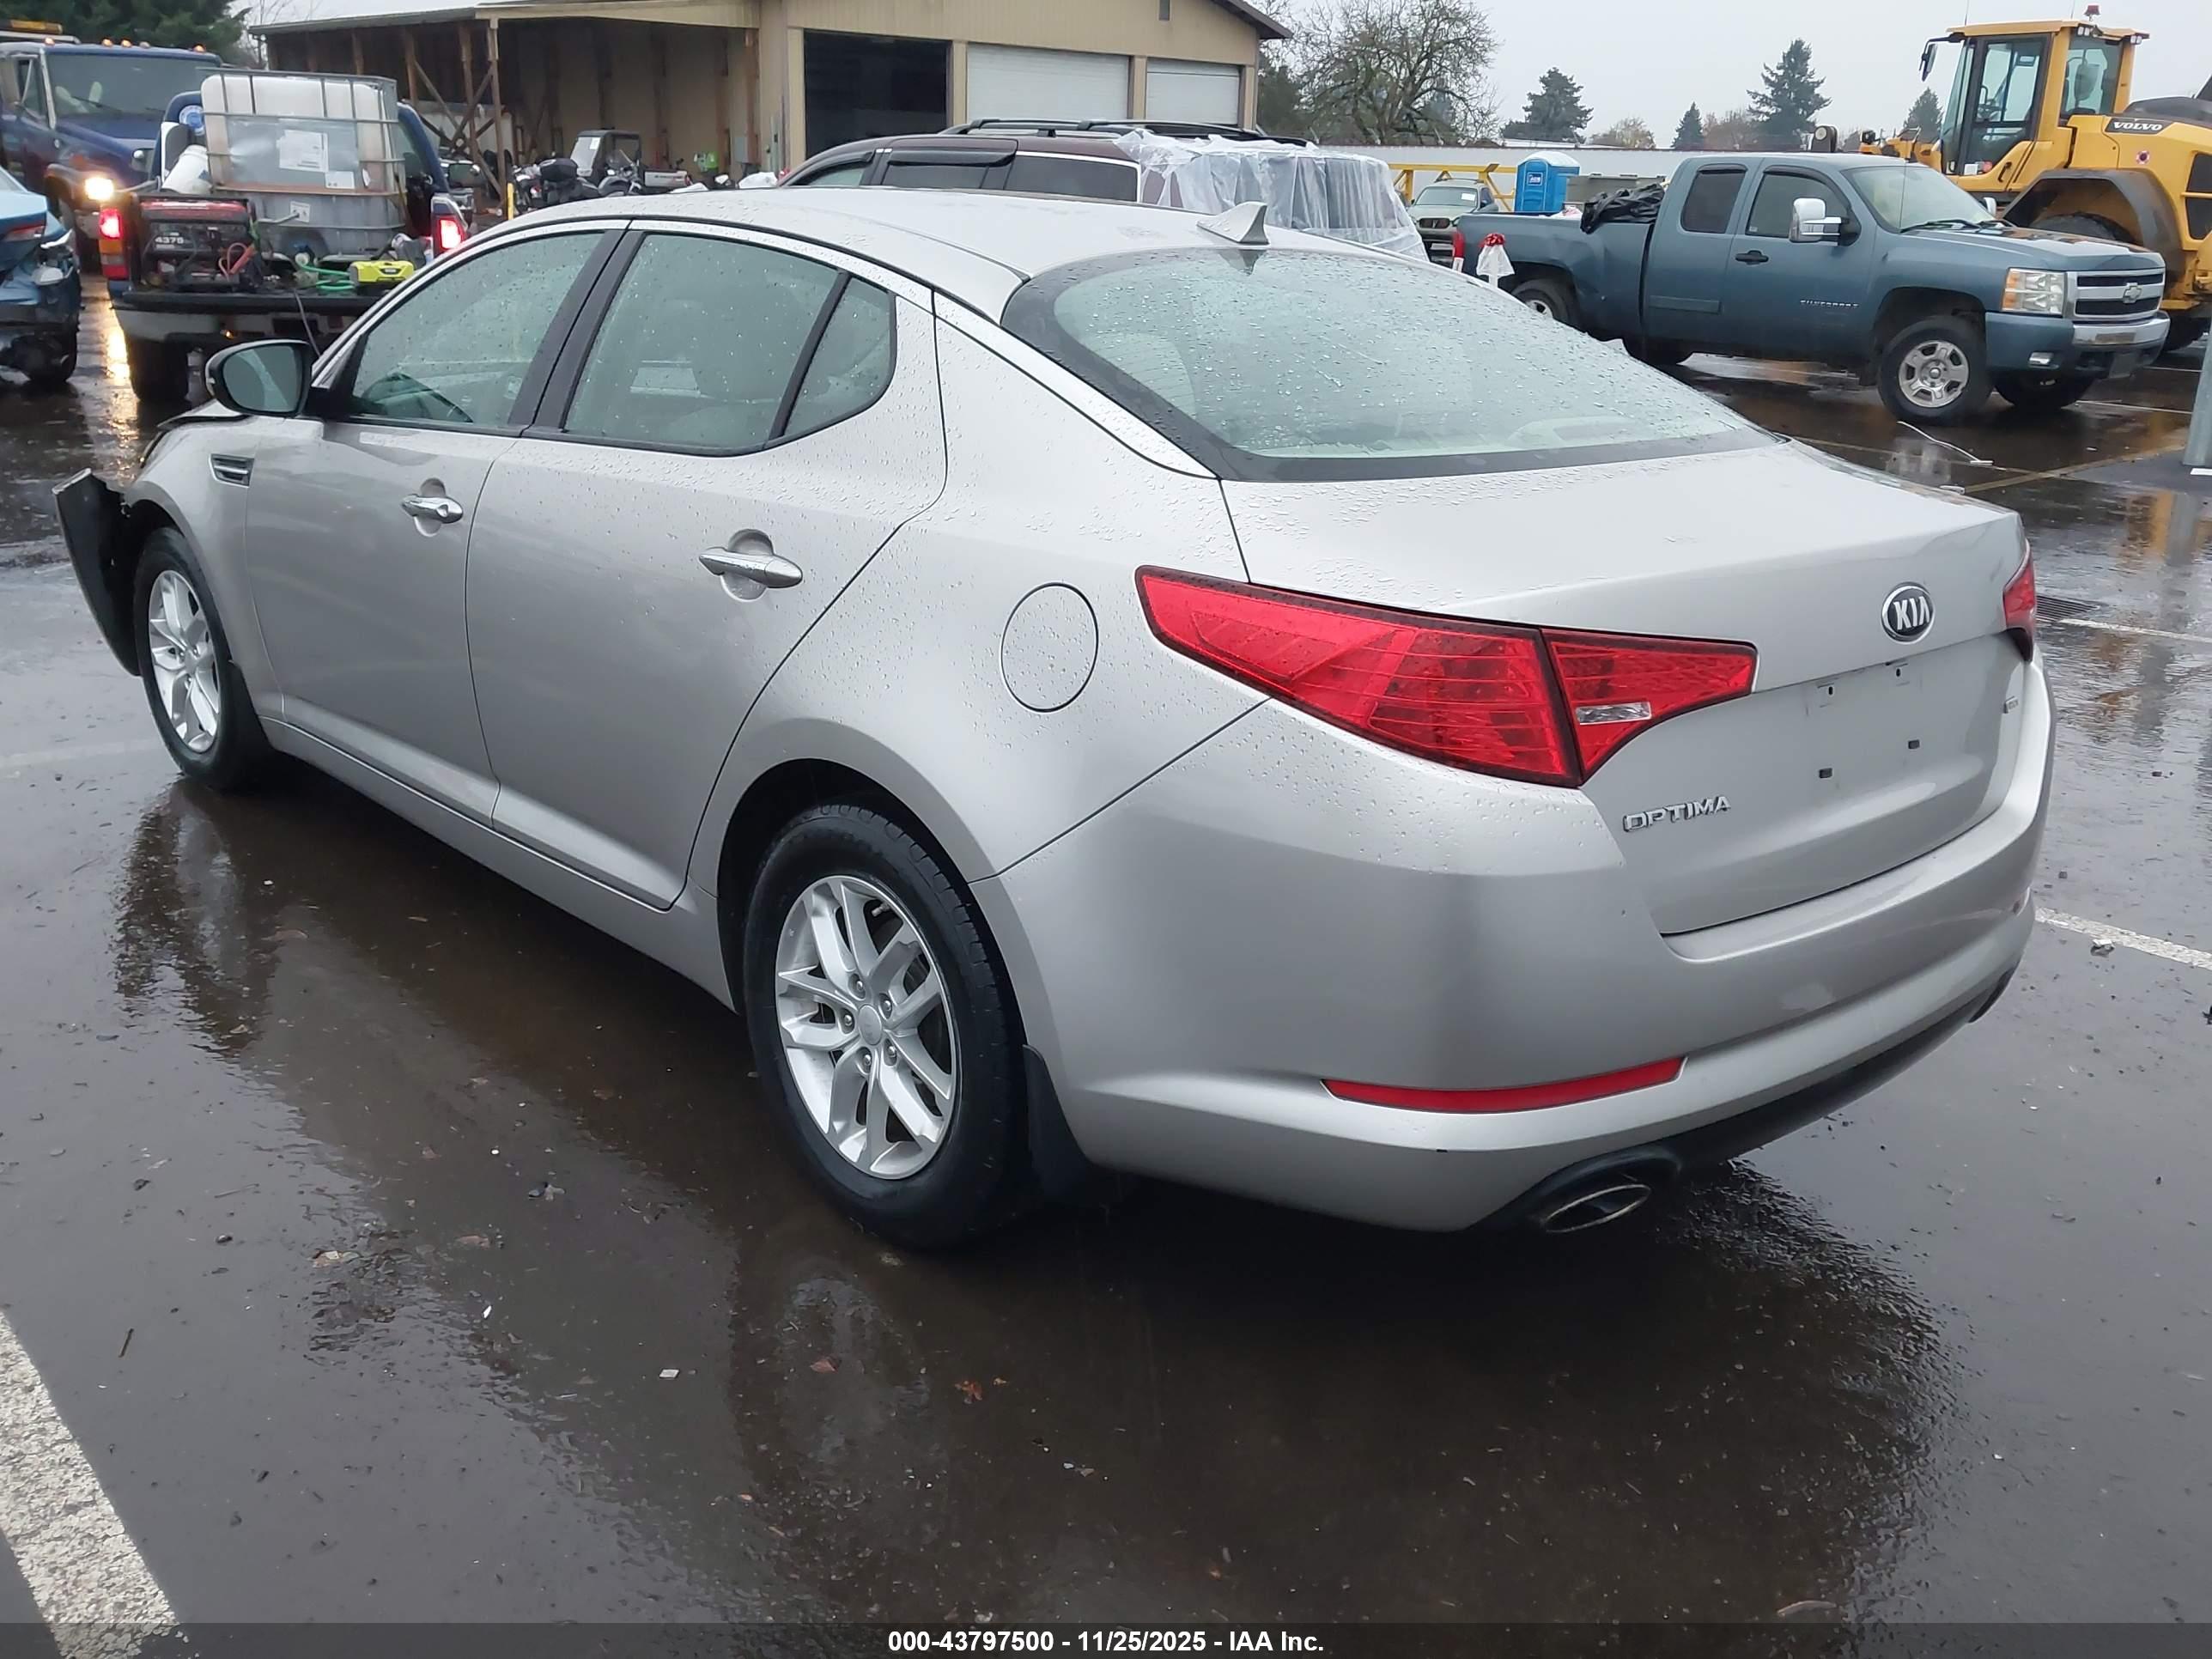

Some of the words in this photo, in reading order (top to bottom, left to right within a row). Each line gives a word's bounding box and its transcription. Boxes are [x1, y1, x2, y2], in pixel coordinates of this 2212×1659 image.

[2113, 121, 2163, 131] VOLVO
[1893, 595, 1930, 630] KIA
[1623, 795, 1731, 832] OPTIMA
